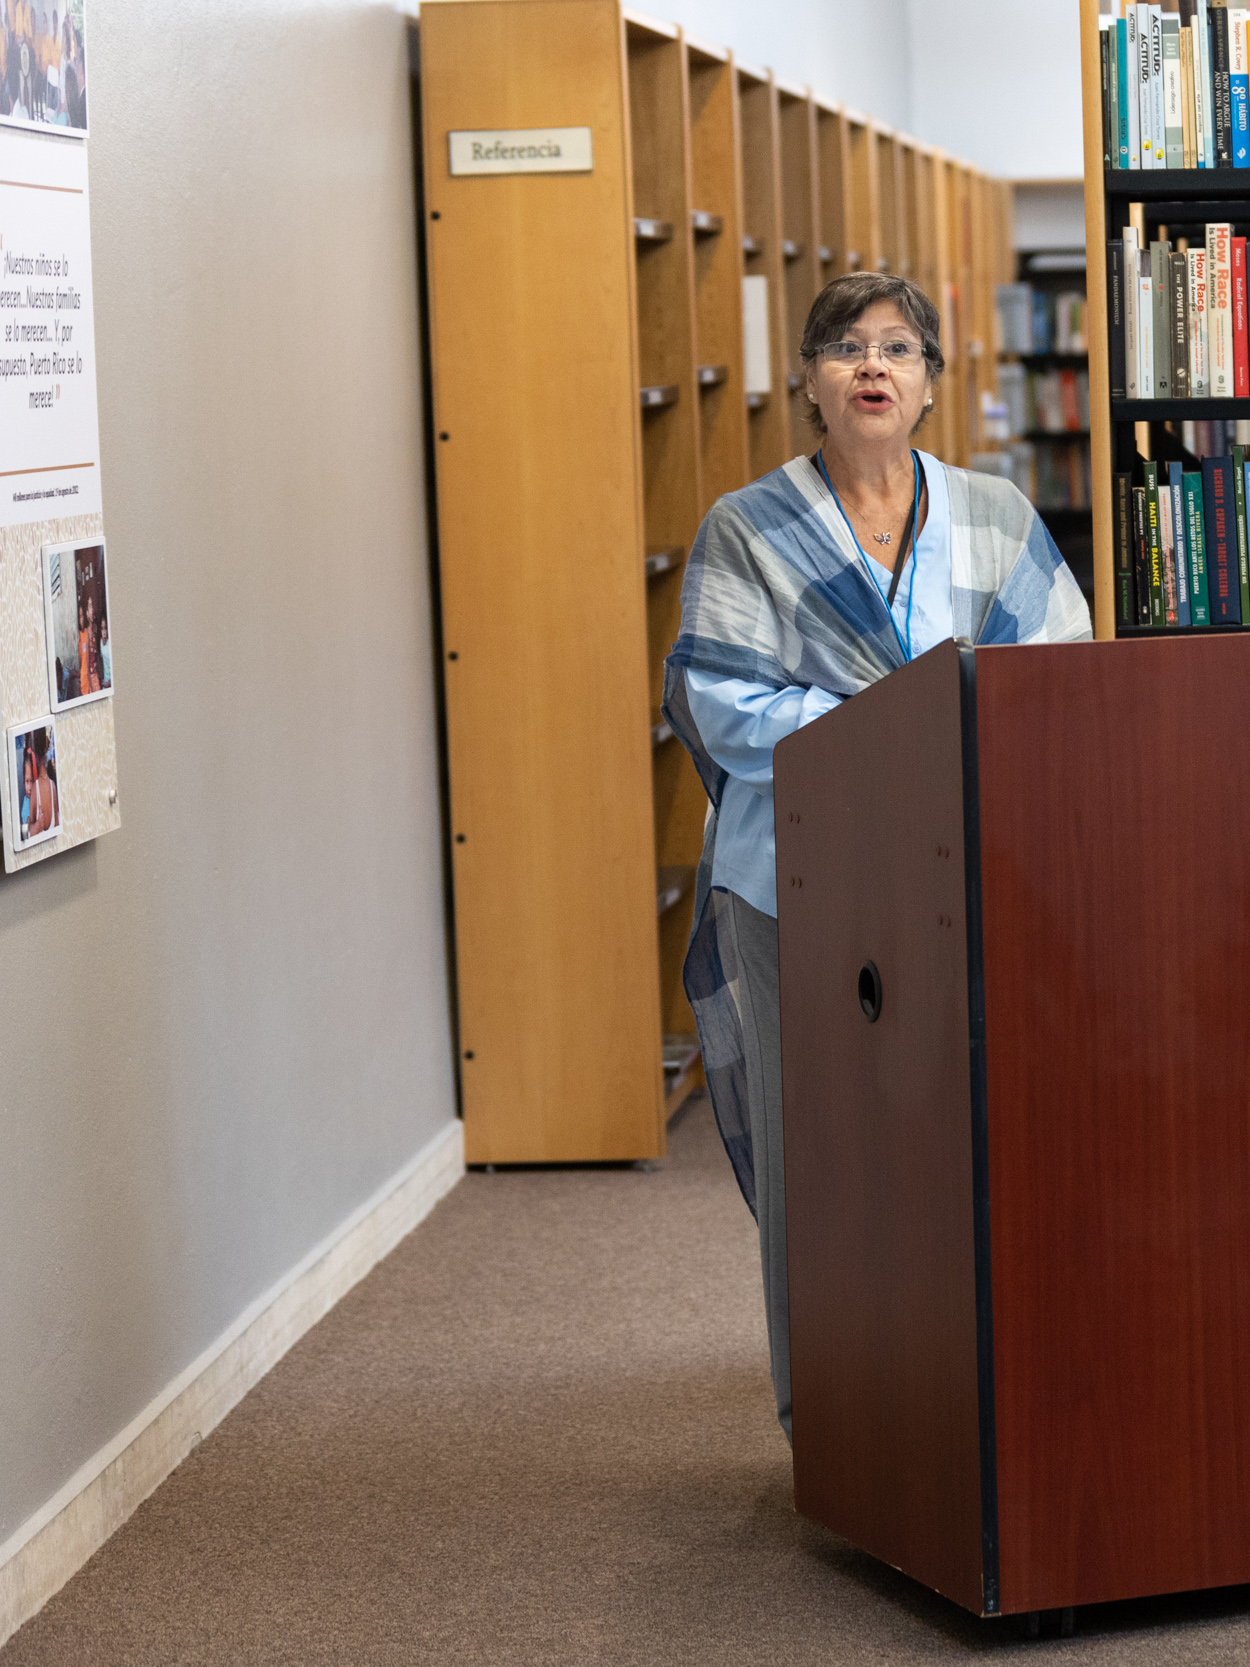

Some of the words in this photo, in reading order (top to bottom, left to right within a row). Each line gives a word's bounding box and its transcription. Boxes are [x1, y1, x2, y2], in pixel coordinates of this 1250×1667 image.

[1234, 53, 1242, 70] Covey
[1215, 89, 1223, 107] WIN
[1223, 91, 1230, 103] TO
[1215, 109, 1223, 131] EVERY
[1238, 103, 1247, 131] HÁBITO
[471, 140, 562, 161] Referencia
[1216, 131, 1224, 150] TIME
[1216, 227, 1229, 263] How
[35, 253, 52, 276] niños
[54, 260, 61, 276] se
[62, 254, 68, 276] lo
[1196, 253, 1205, 279] How
[1209, 262, 1216, 270] in
[56, 287, 81, 312] familias
[1197, 284, 1206, 312] Race
[1217, 270, 1229, 308] Race
[1176, 287, 1184, 318] POWER
[1236, 301, 1244, 330] Equations
[5, 325, 12, 342] se
[14, 318, 19, 342] lo
[55, 319, 60, 345] Y,
[62, 326, 72, 346] por
[1176, 322, 1185, 344] ELITE
[30, 353, 50, 375] Puerto
[52, 352, 66, 374] Rico
[68, 358, 74, 374] se
[76, 351, 82, 374] lo
[29, 385, 53, 408] merece!
[1149, 502, 1157, 527] HAITI
[1151, 547, 1160, 586] BALANCE
